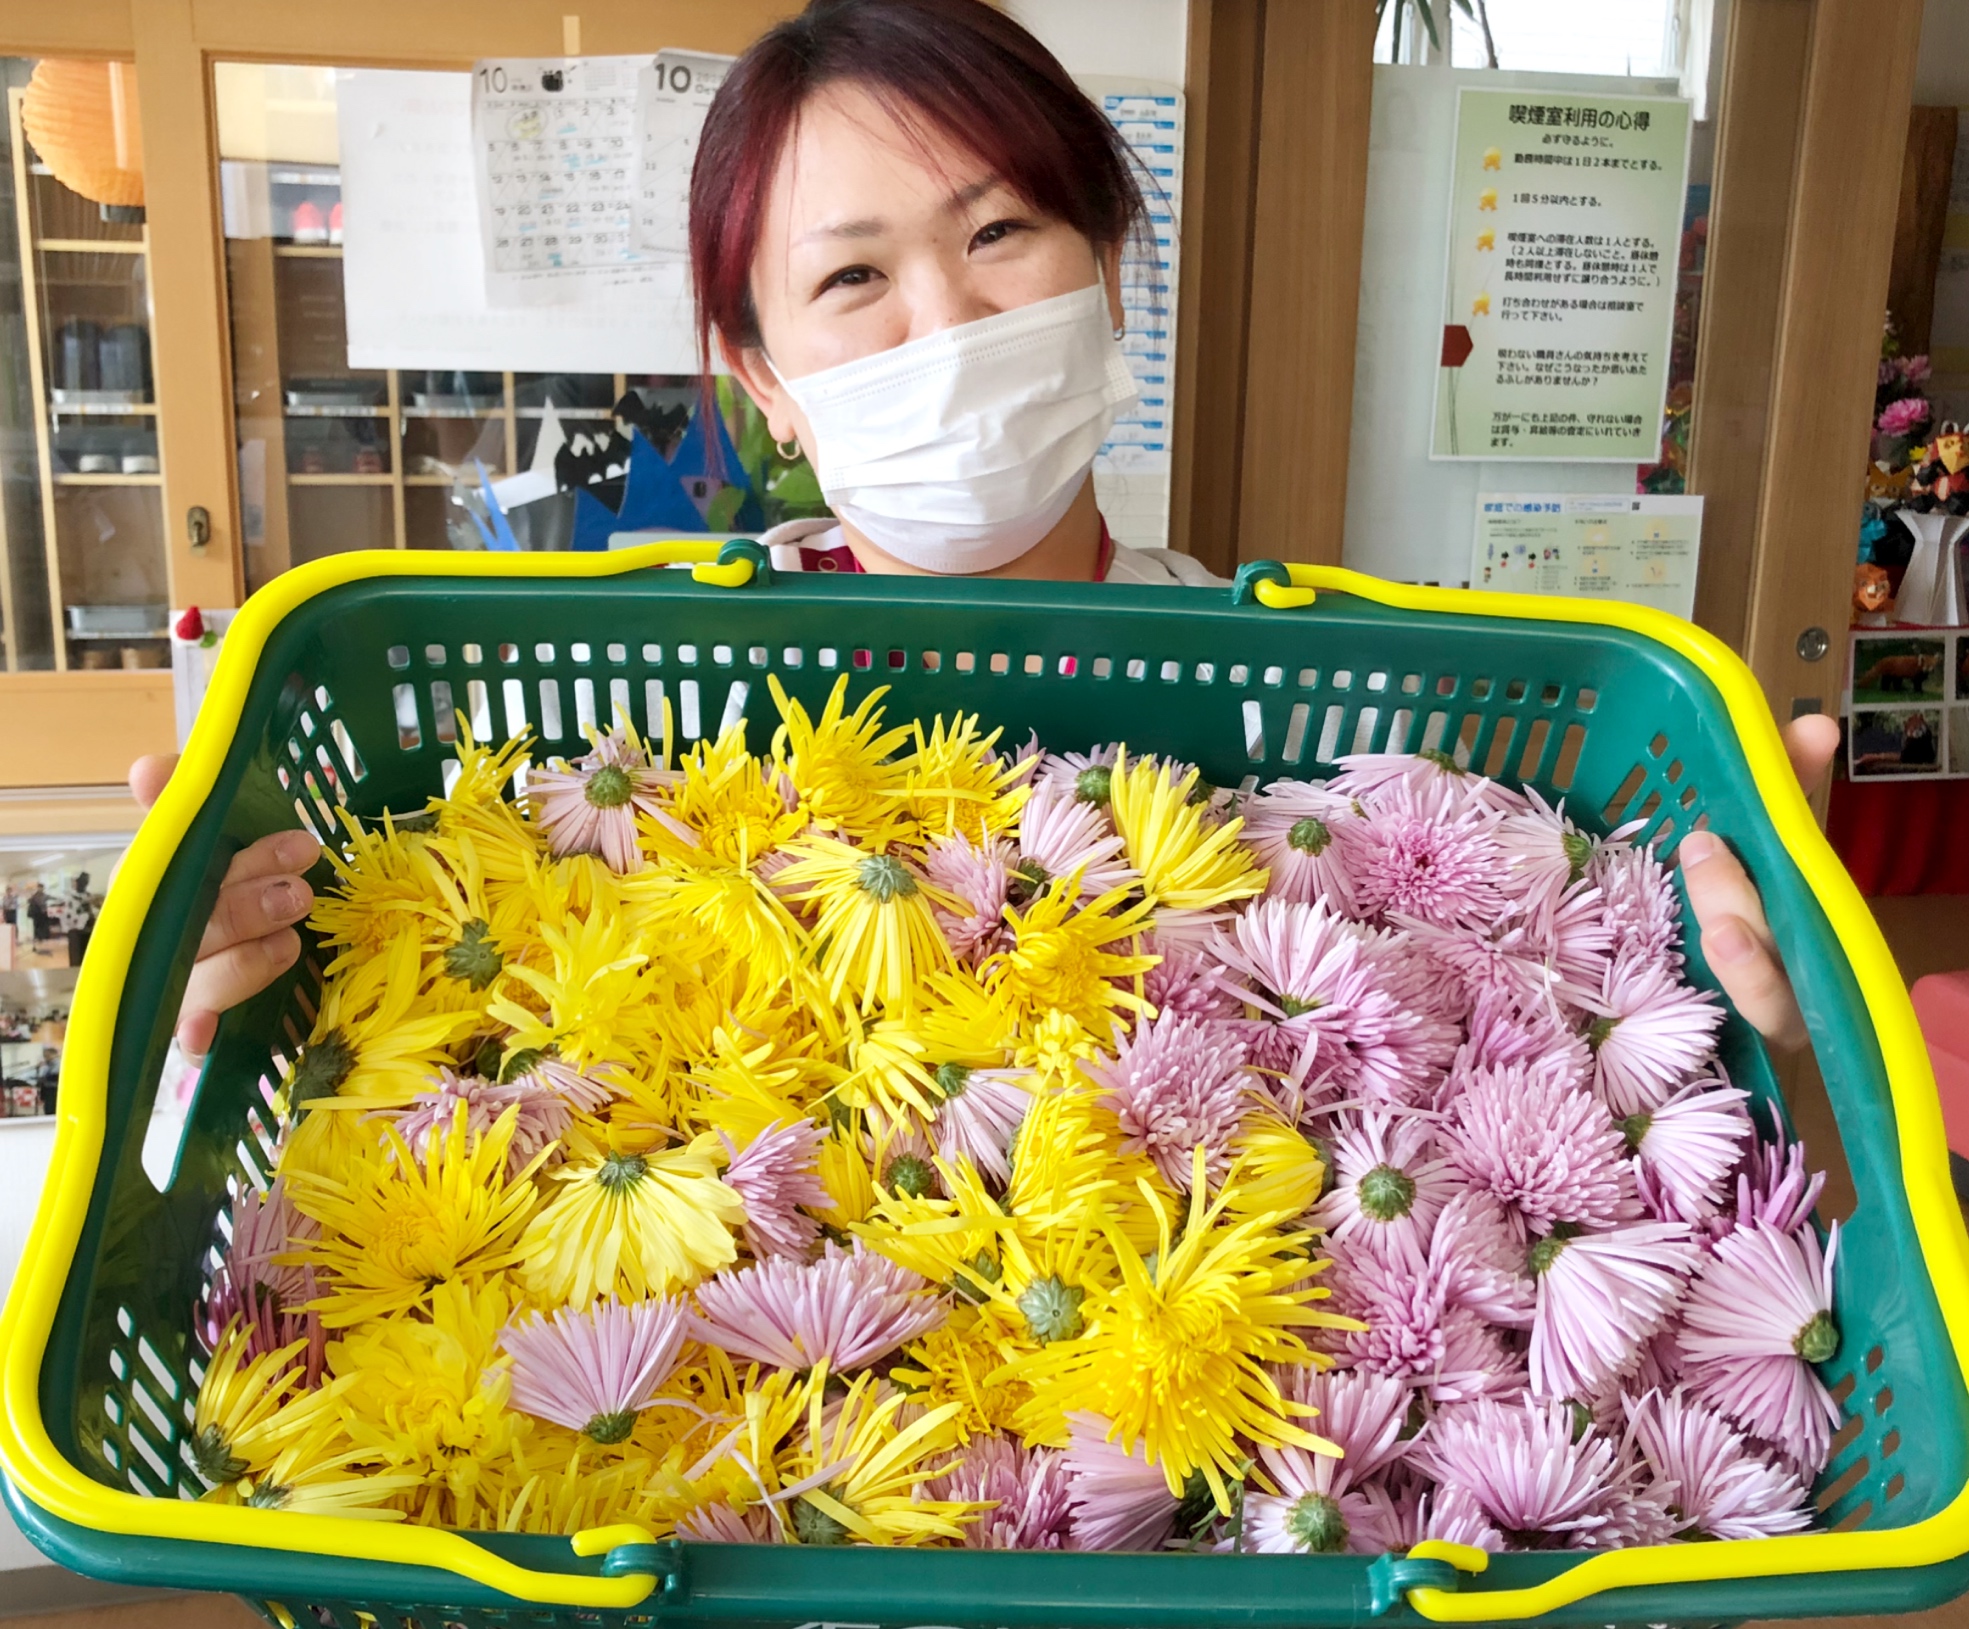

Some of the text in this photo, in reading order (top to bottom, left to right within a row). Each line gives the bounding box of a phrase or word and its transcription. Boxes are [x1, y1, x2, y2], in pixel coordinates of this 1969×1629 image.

[479, 66, 508, 94] 10
[655, 63, 691, 94] 10
[1509, 104, 1651, 132] 喫煙室利用の心得
[1542, 134, 1614, 148] 必ず守るように。
[1513, 193, 1602, 207] 1回5分以内とする。
[1501, 310, 1563, 322] 行って下さい。
[1490, 437, 1513, 447] ます。
